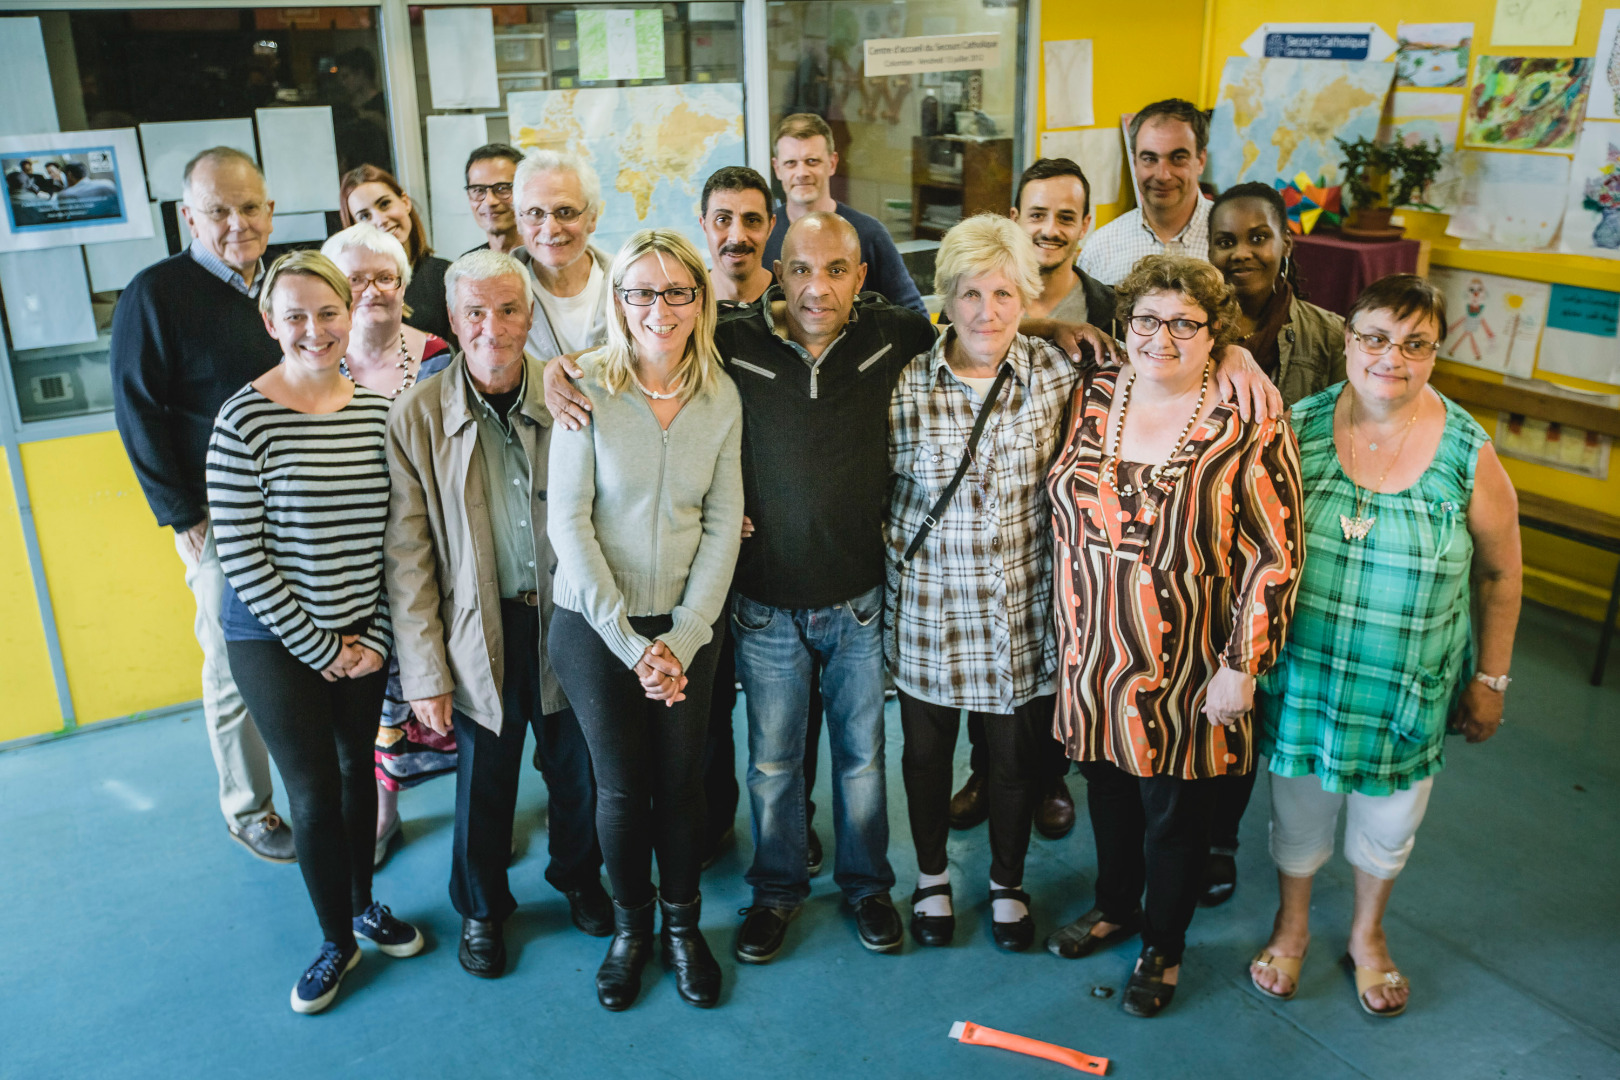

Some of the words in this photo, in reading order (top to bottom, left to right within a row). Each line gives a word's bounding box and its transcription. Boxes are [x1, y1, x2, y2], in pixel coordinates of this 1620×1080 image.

[869, 46, 891, 56] Centre
[935, 43, 960, 51] Secours
[963, 41, 998, 51] Catholique
[1285, 34, 1319, 47] Secours
[1321, 35, 1368, 49] Catholique
